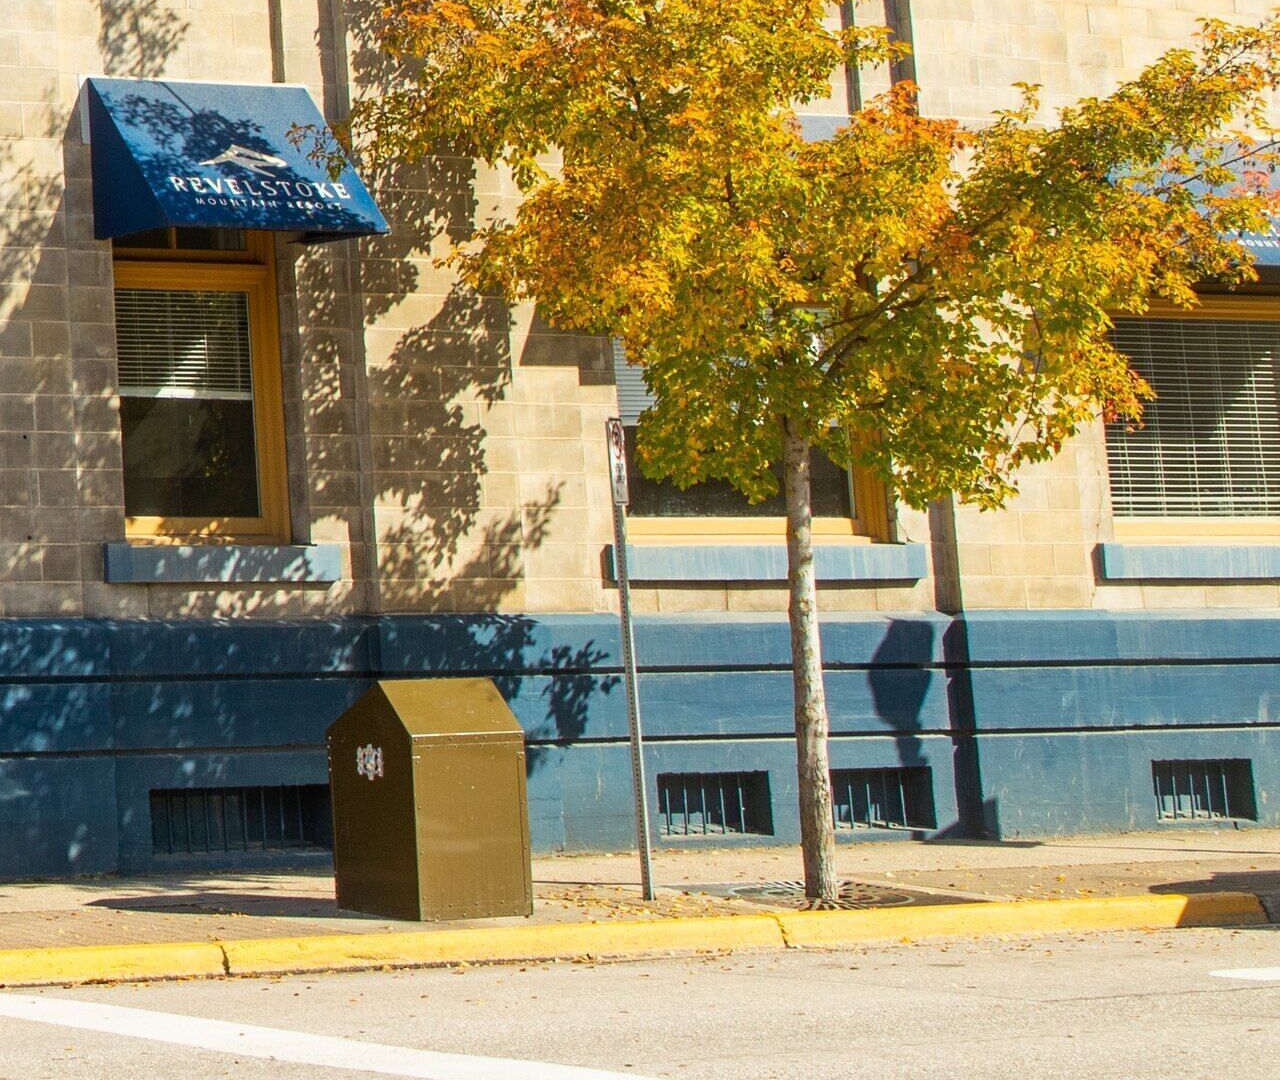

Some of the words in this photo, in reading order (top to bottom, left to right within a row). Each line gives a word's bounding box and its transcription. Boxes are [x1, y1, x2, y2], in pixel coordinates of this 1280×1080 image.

[169, 176, 351, 199] REVELSTOKE
[195, 197, 277, 208] MOUNTAIN
[287, 200, 343, 210] RESORT
